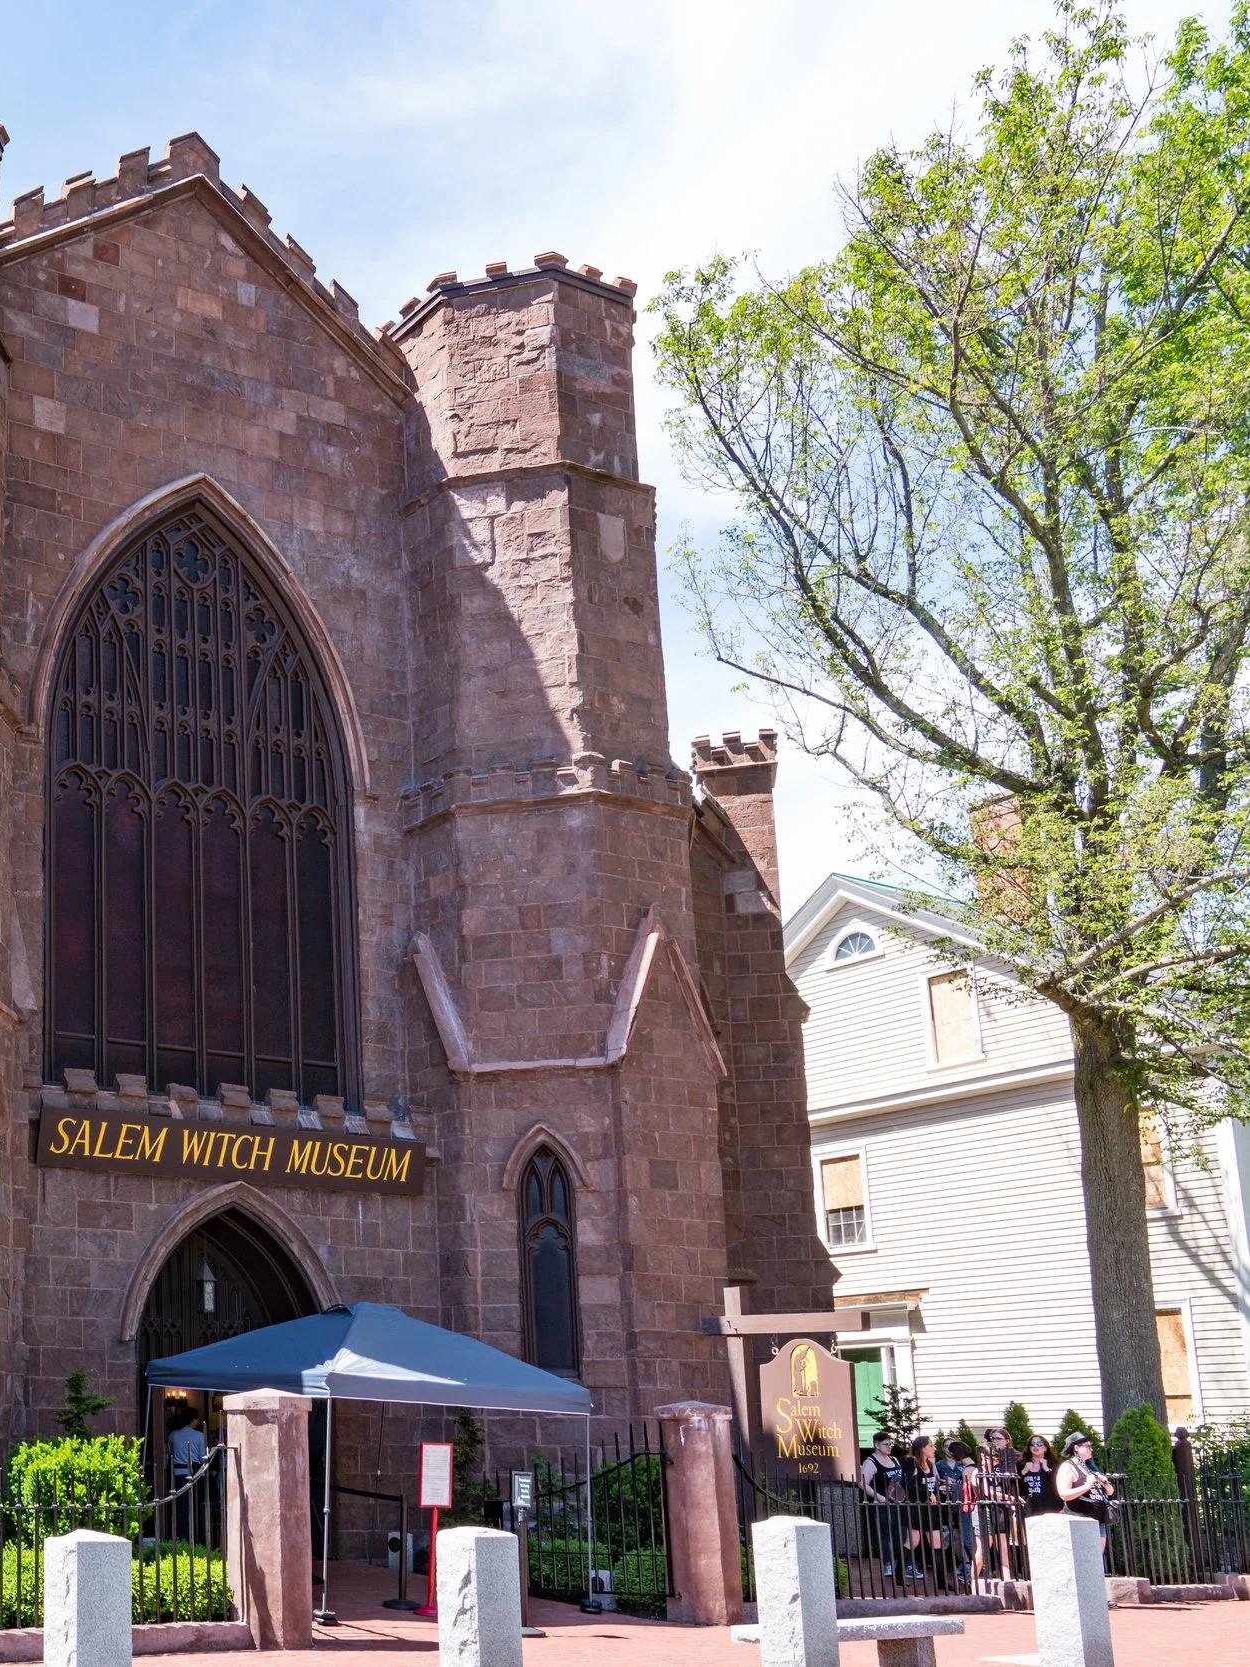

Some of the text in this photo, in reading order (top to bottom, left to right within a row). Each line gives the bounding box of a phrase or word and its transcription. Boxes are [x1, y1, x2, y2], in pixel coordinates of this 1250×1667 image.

[49, 1117, 413, 1182] SALEM WITCH MUSEUM
[776, 1398, 821, 1433] Salem
[796, 1418, 842, 1443] Witch
[776, 1434, 839, 1459] Museum
[798, 1463, 820, 1474] 1692
